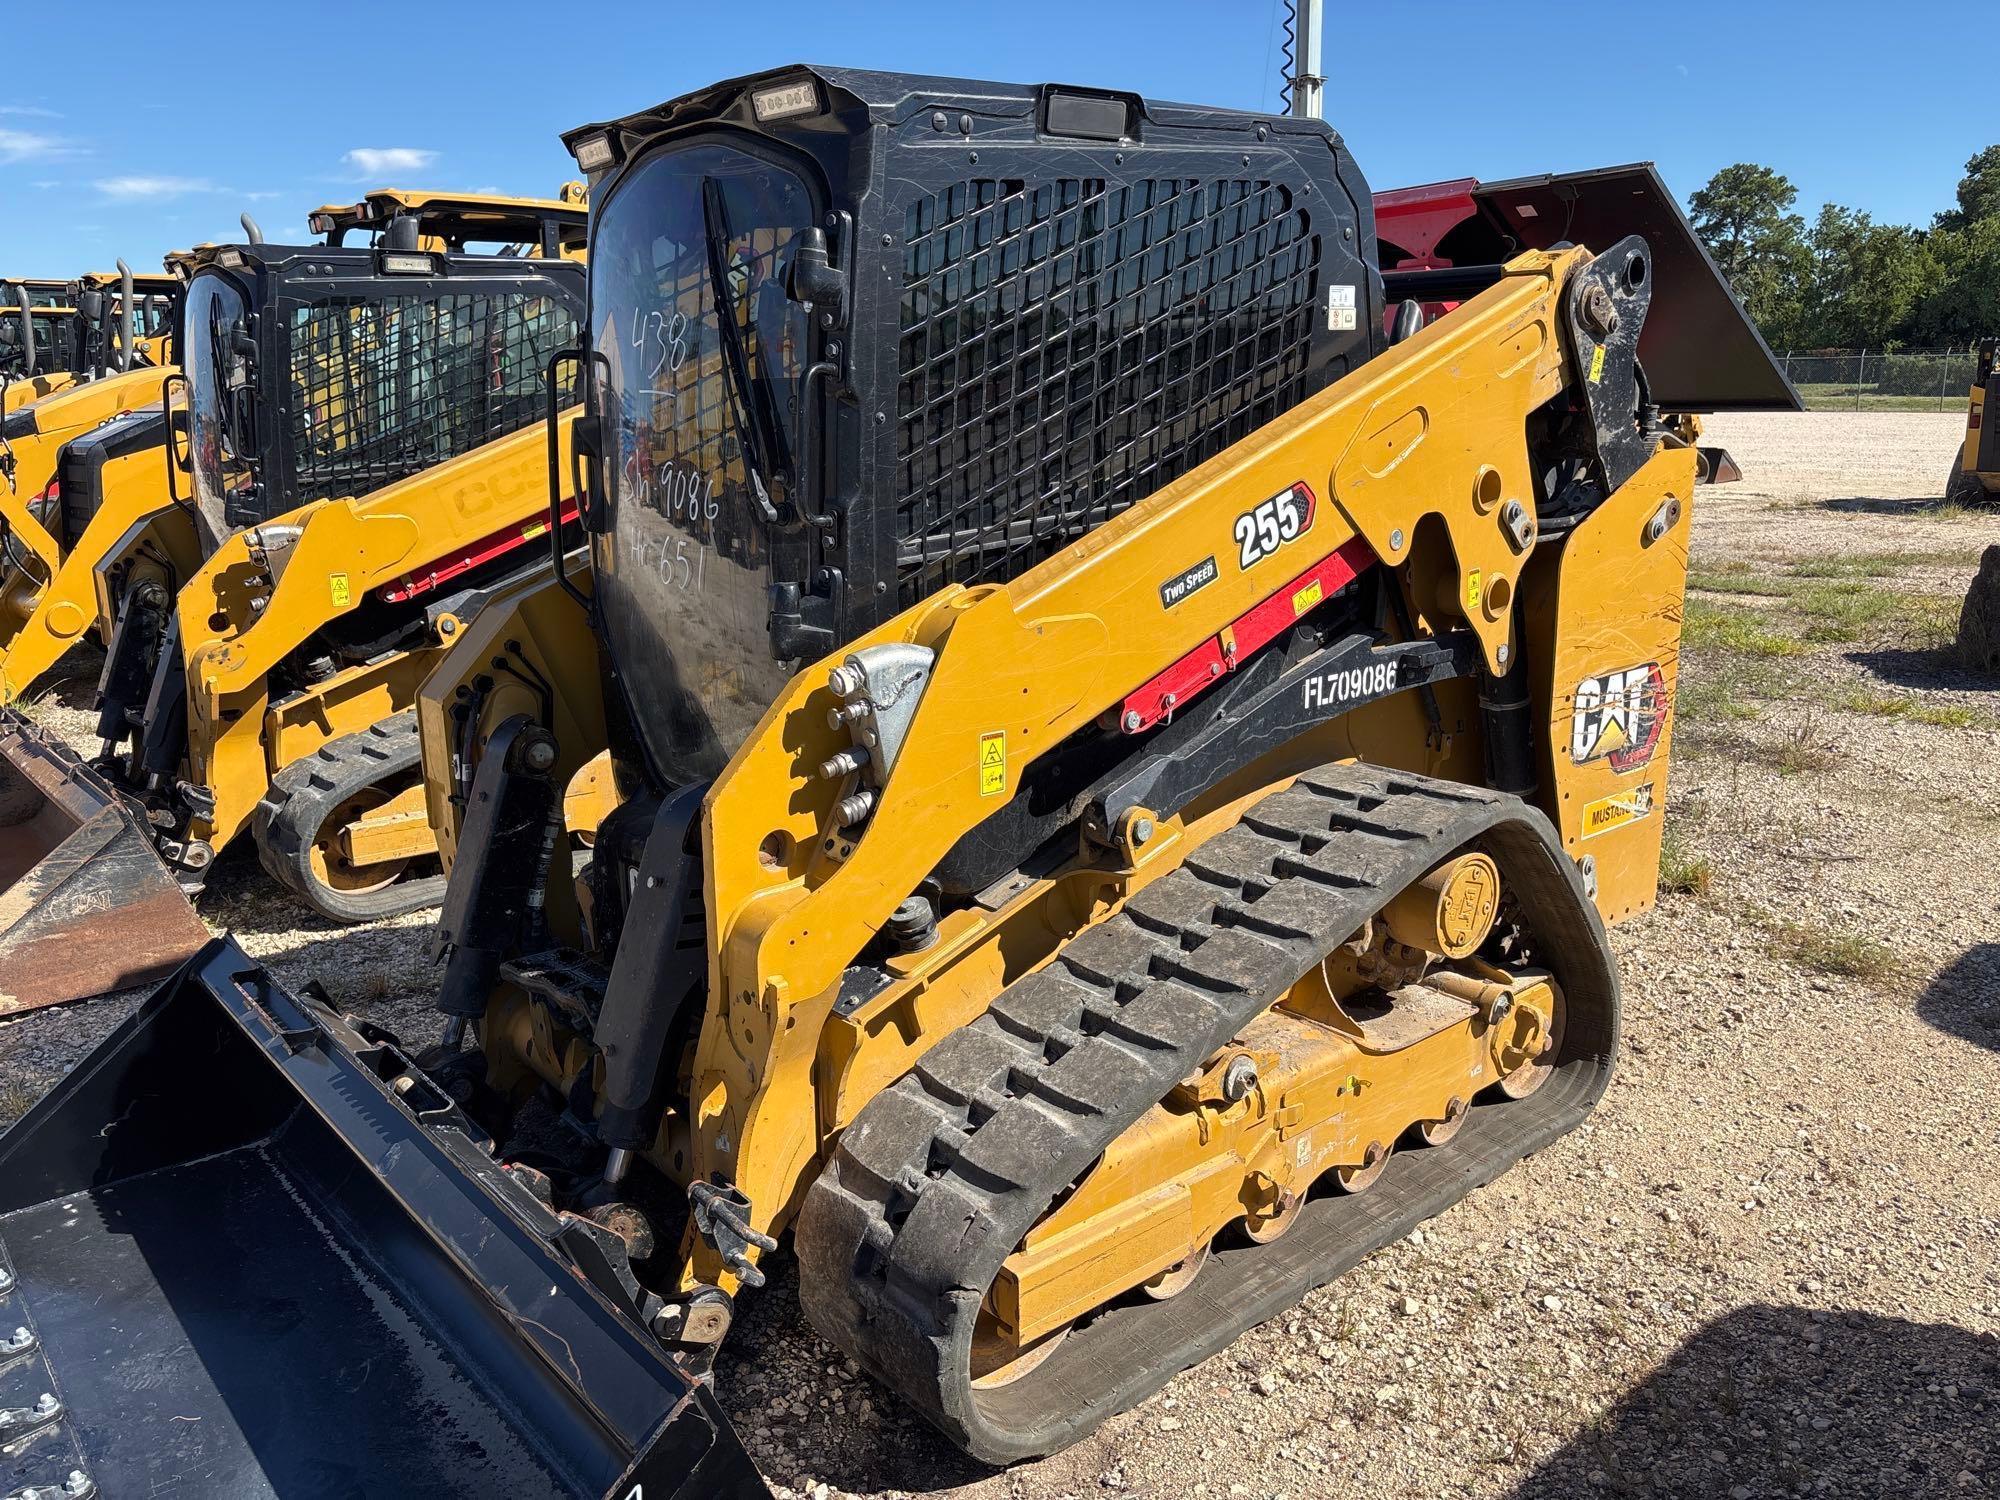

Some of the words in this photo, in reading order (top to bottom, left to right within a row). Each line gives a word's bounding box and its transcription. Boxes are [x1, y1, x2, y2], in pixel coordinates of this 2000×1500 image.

[661, 461, 719, 520] 9086
[1235, 489, 1300, 567] 255
[660, 535, 705, 591] 651
[1304, 660, 1398, 709] FL709086
[1572, 665, 1650, 762] CAT
